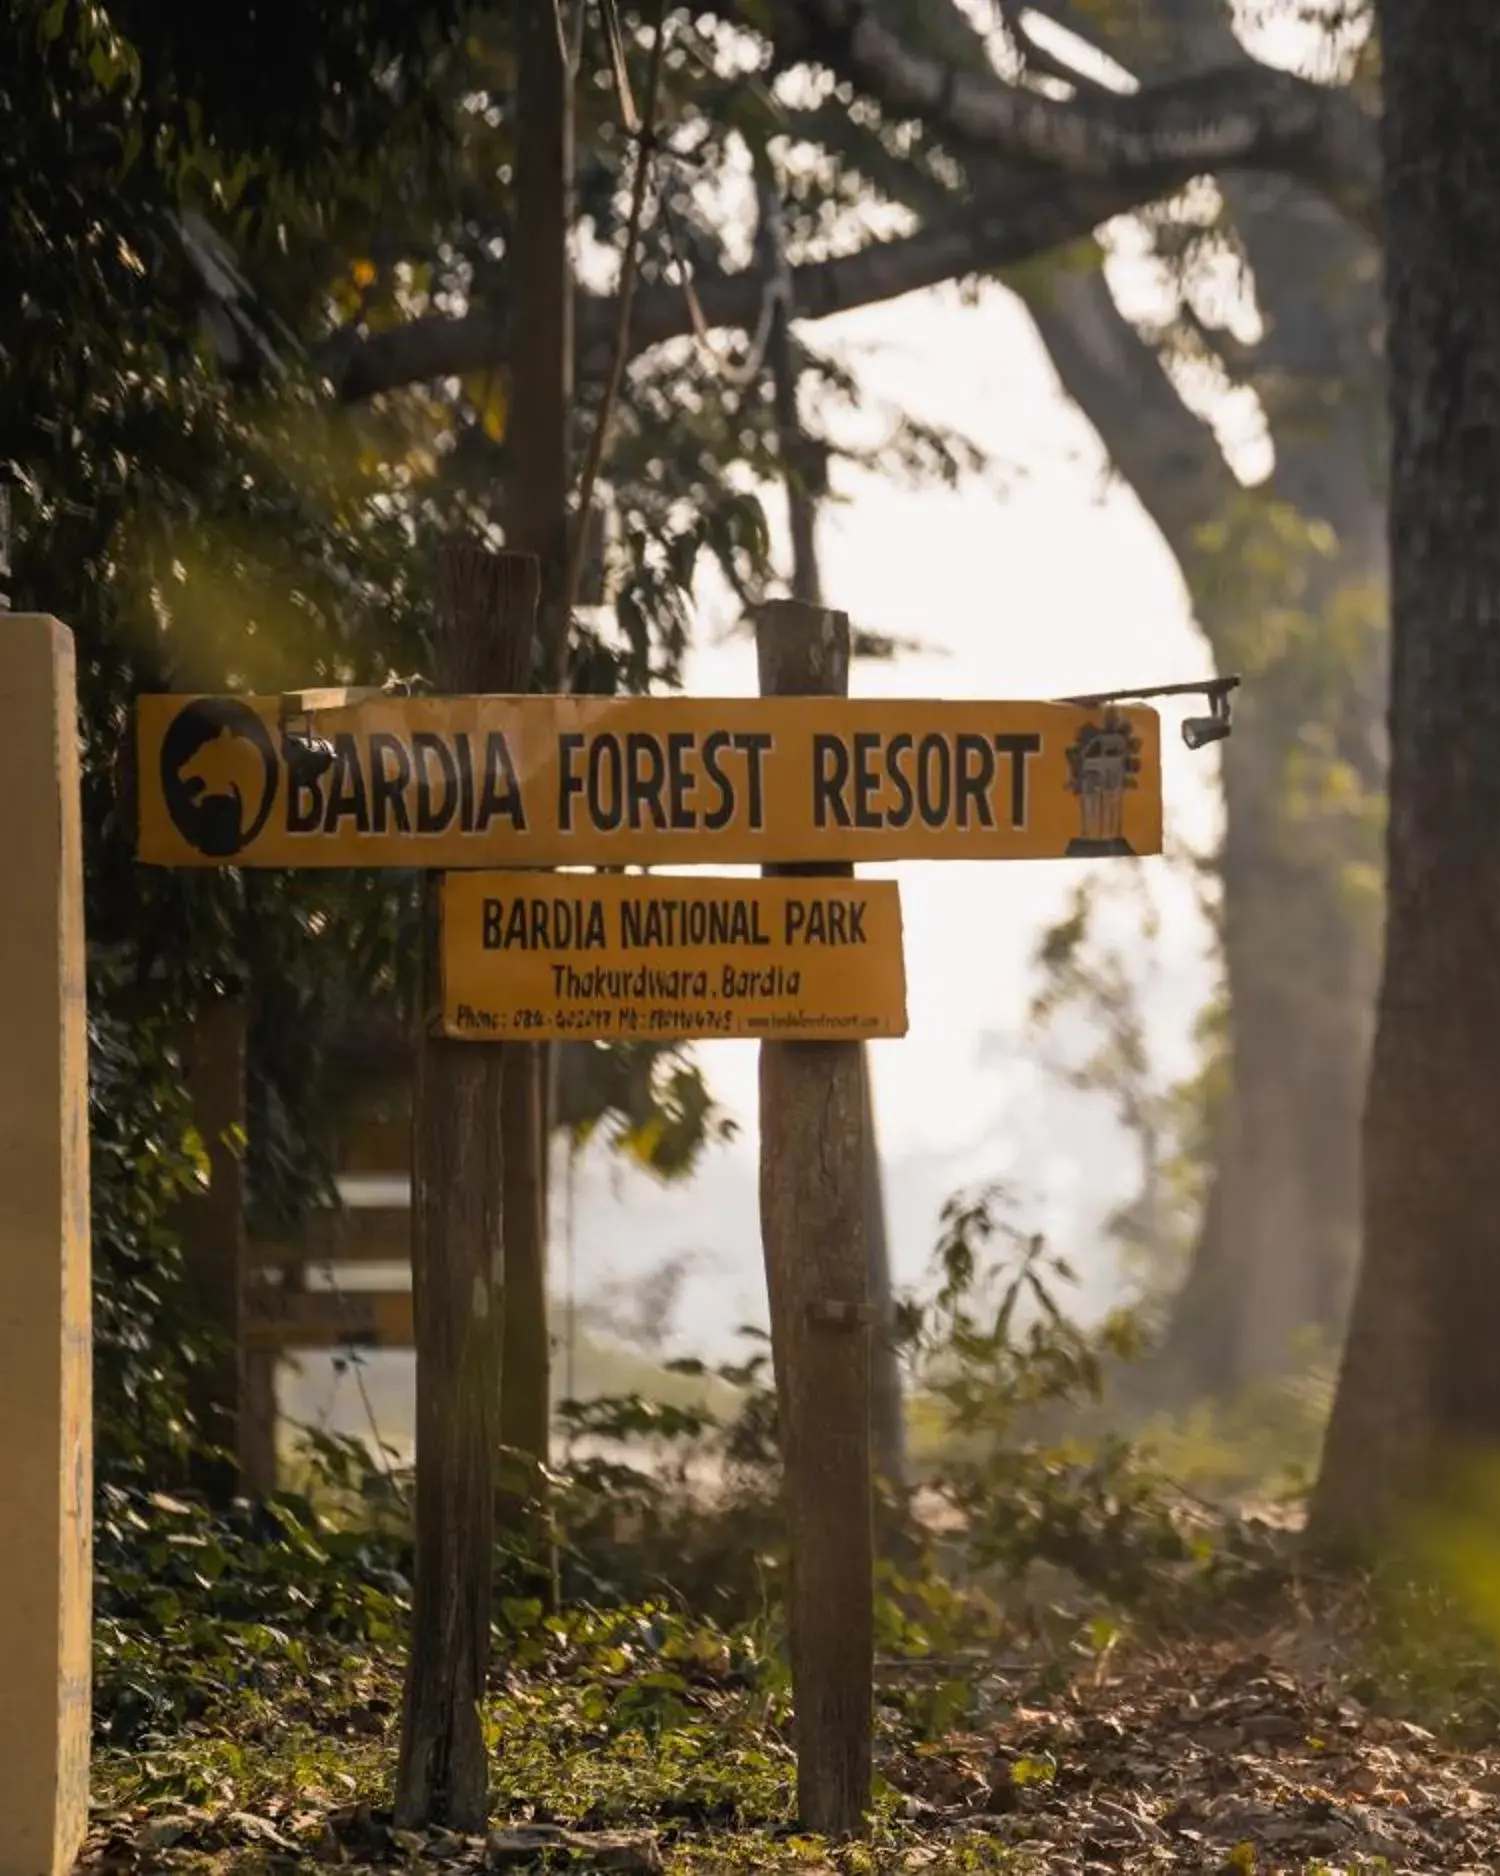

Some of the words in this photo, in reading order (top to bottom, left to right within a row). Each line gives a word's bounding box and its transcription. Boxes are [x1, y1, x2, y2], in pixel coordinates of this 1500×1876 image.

[287, 732, 526, 834] BARDIA
[557, 732, 773, 831] FOREST
[812, 732, 1040, 829] RESORT
[482, 897, 605, 951] BARDIA
[620, 898, 769, 949] NATIONAL
[785, 899, 867, 945] PARK
[723, 963, 801, 998] Bardia
